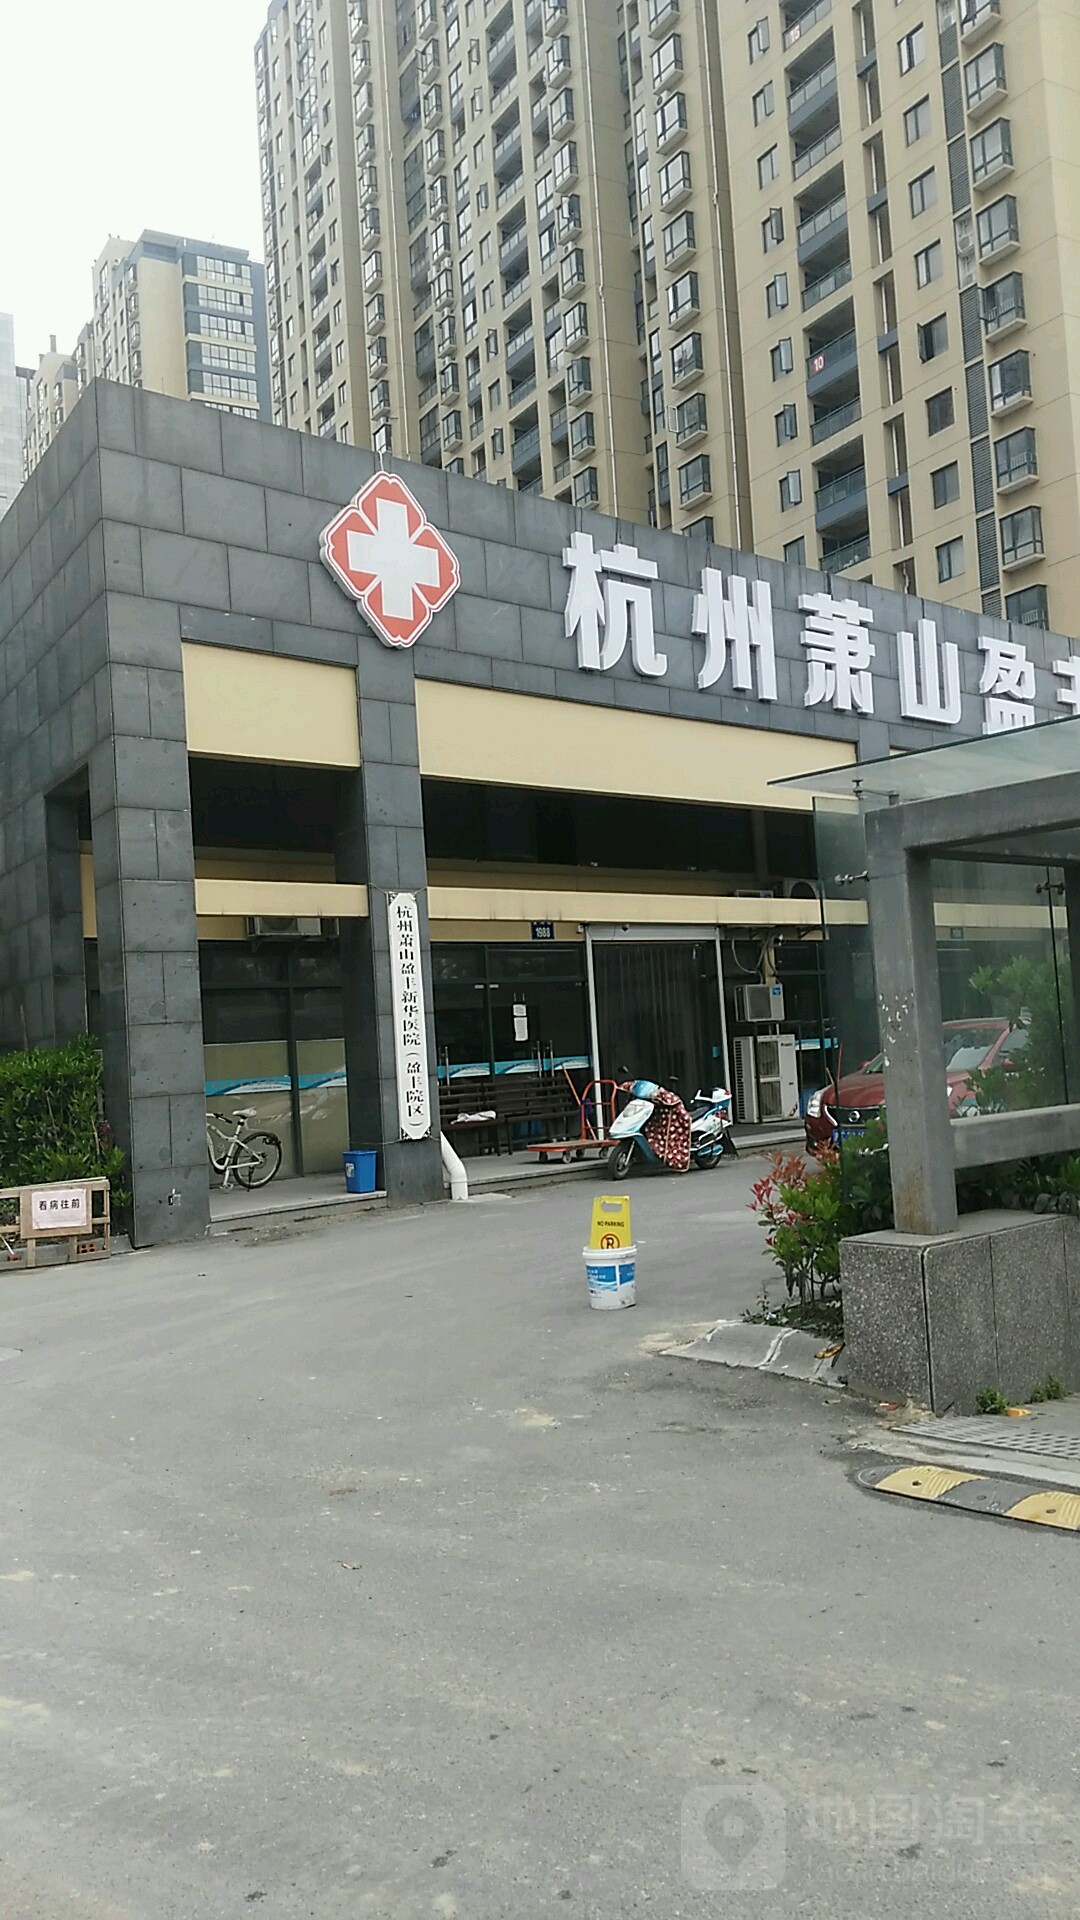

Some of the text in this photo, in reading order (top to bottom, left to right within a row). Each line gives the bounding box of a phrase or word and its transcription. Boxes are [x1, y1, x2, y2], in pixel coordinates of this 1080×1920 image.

[813, 356, 824, 371] 10
[39, 1198, 80, 1211] 看病往前
